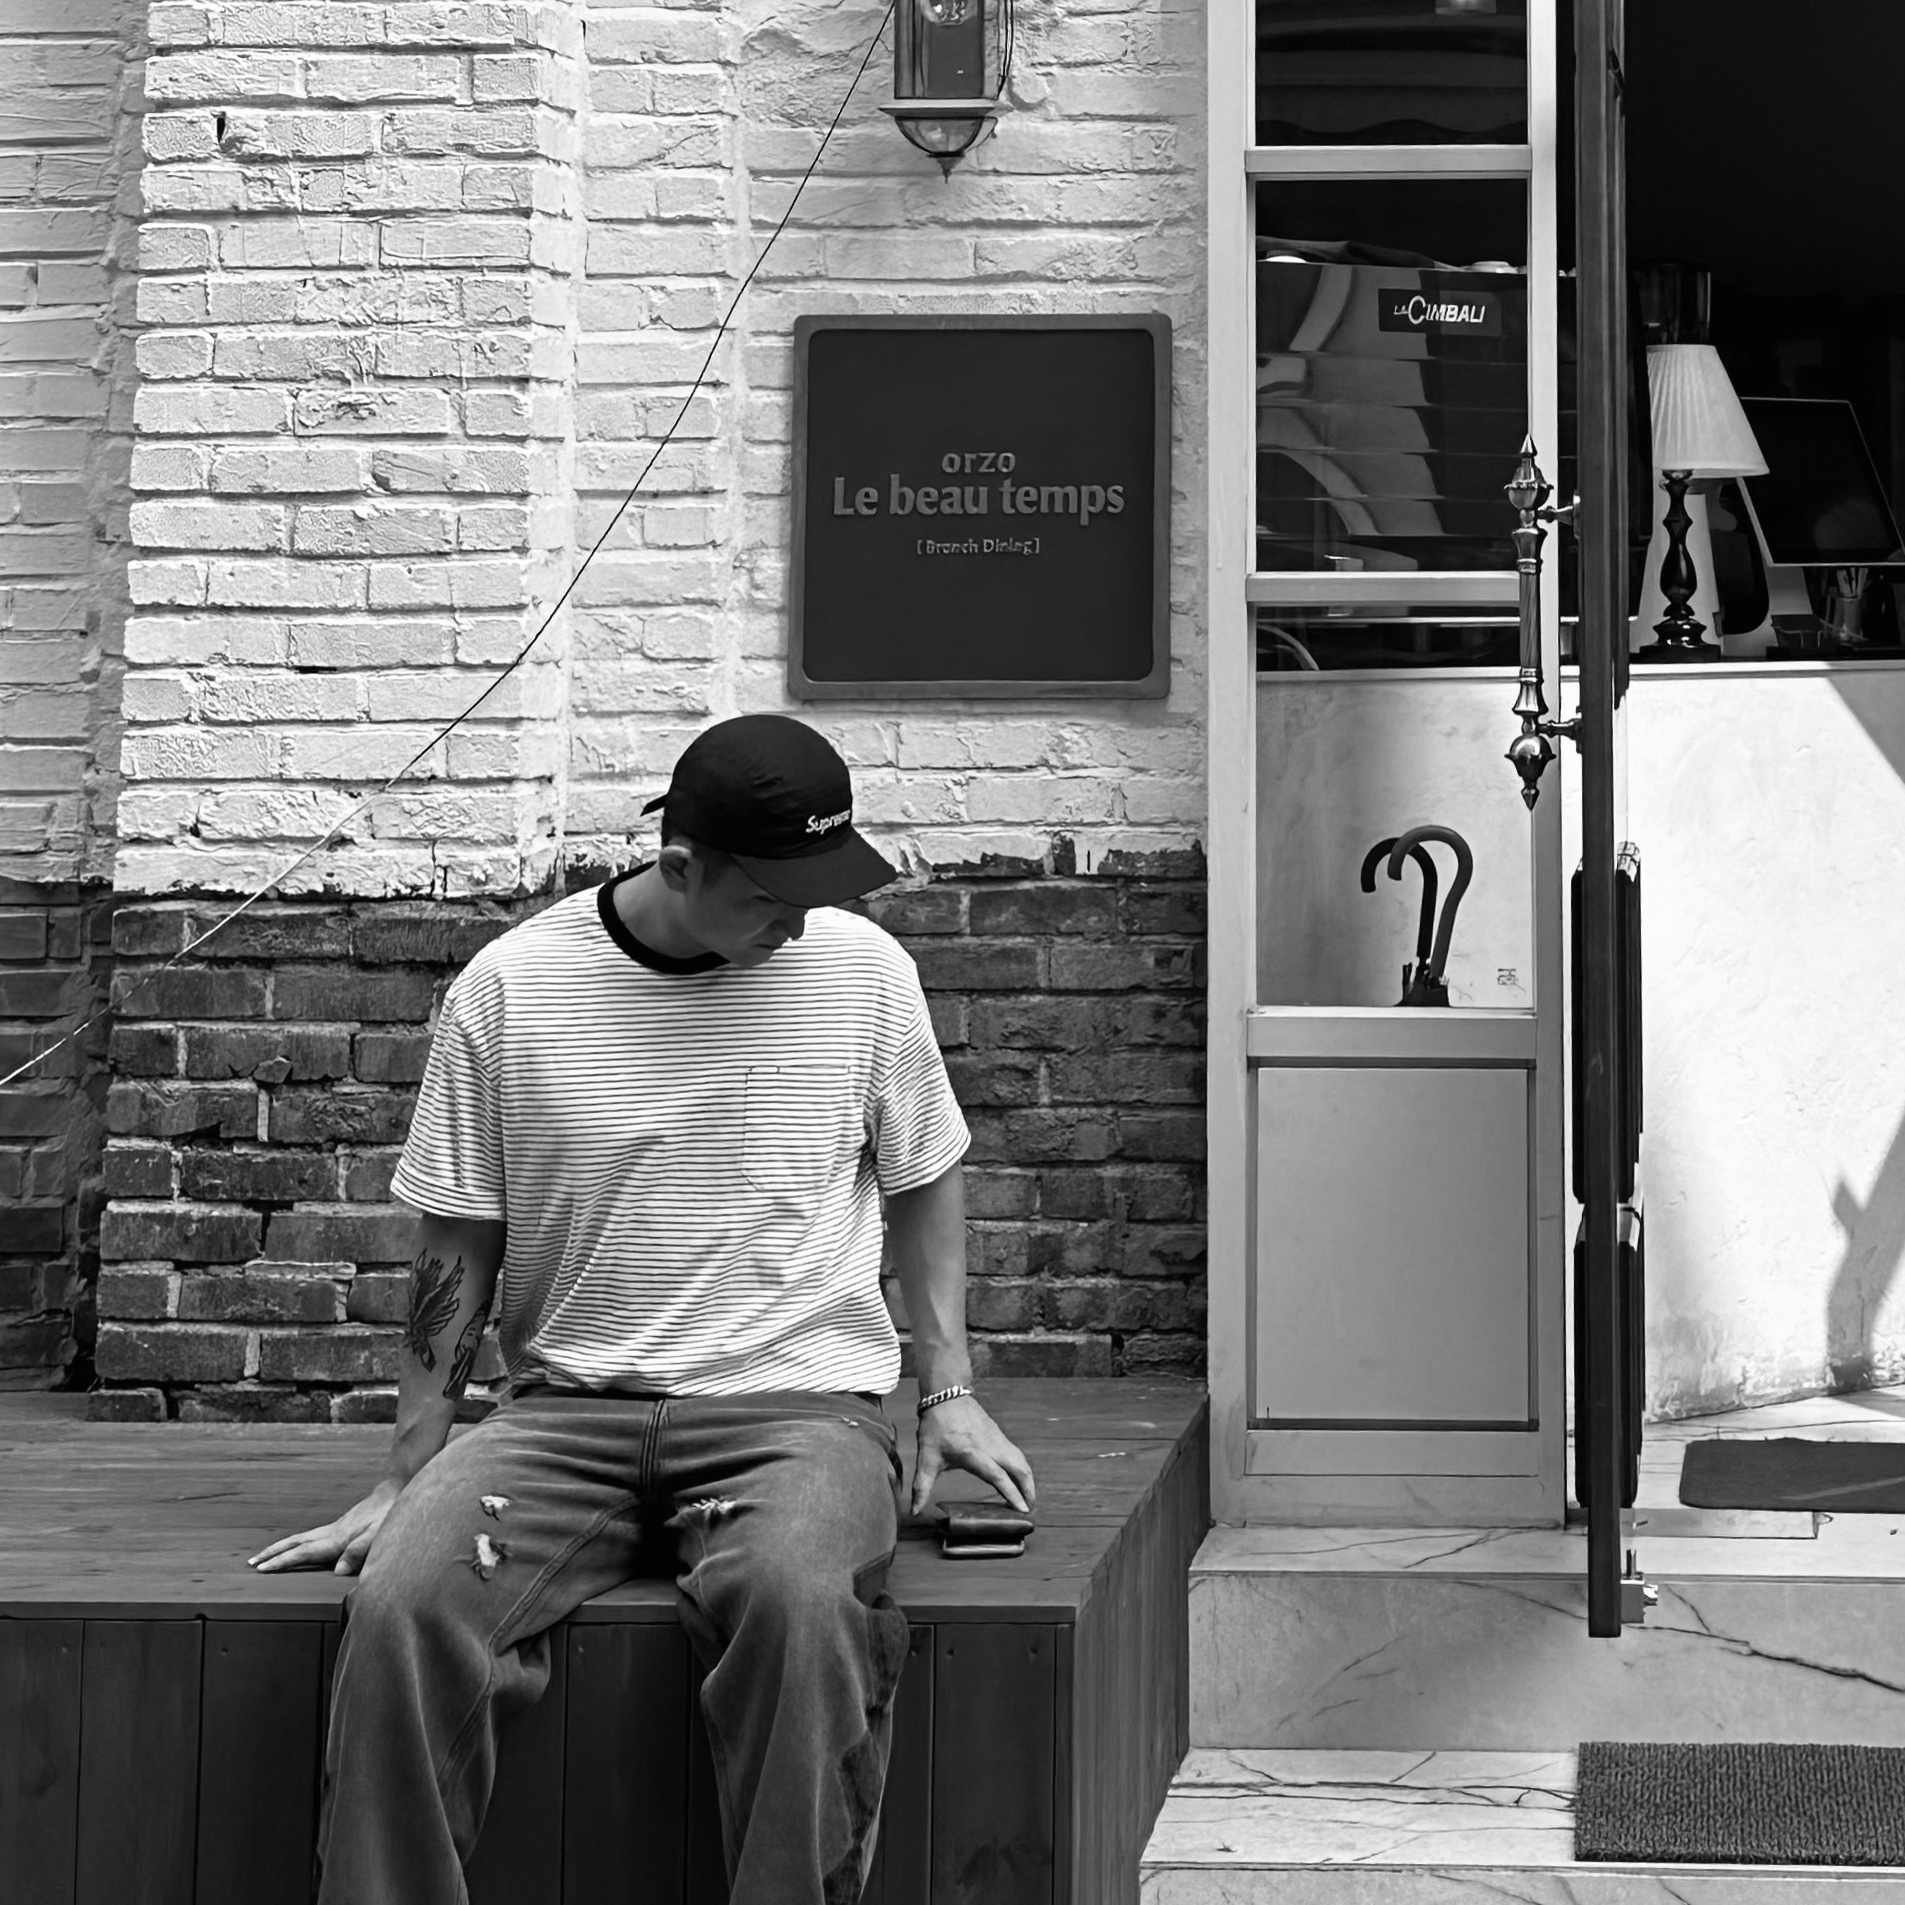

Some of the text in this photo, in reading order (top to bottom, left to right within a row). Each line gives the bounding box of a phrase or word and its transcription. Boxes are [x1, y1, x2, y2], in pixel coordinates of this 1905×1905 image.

[1407, 295, 1486, 325] CIMBALI
[941, 452, 1016, 474] orzo
[833, 474, 1126, 526] Le beau temps
